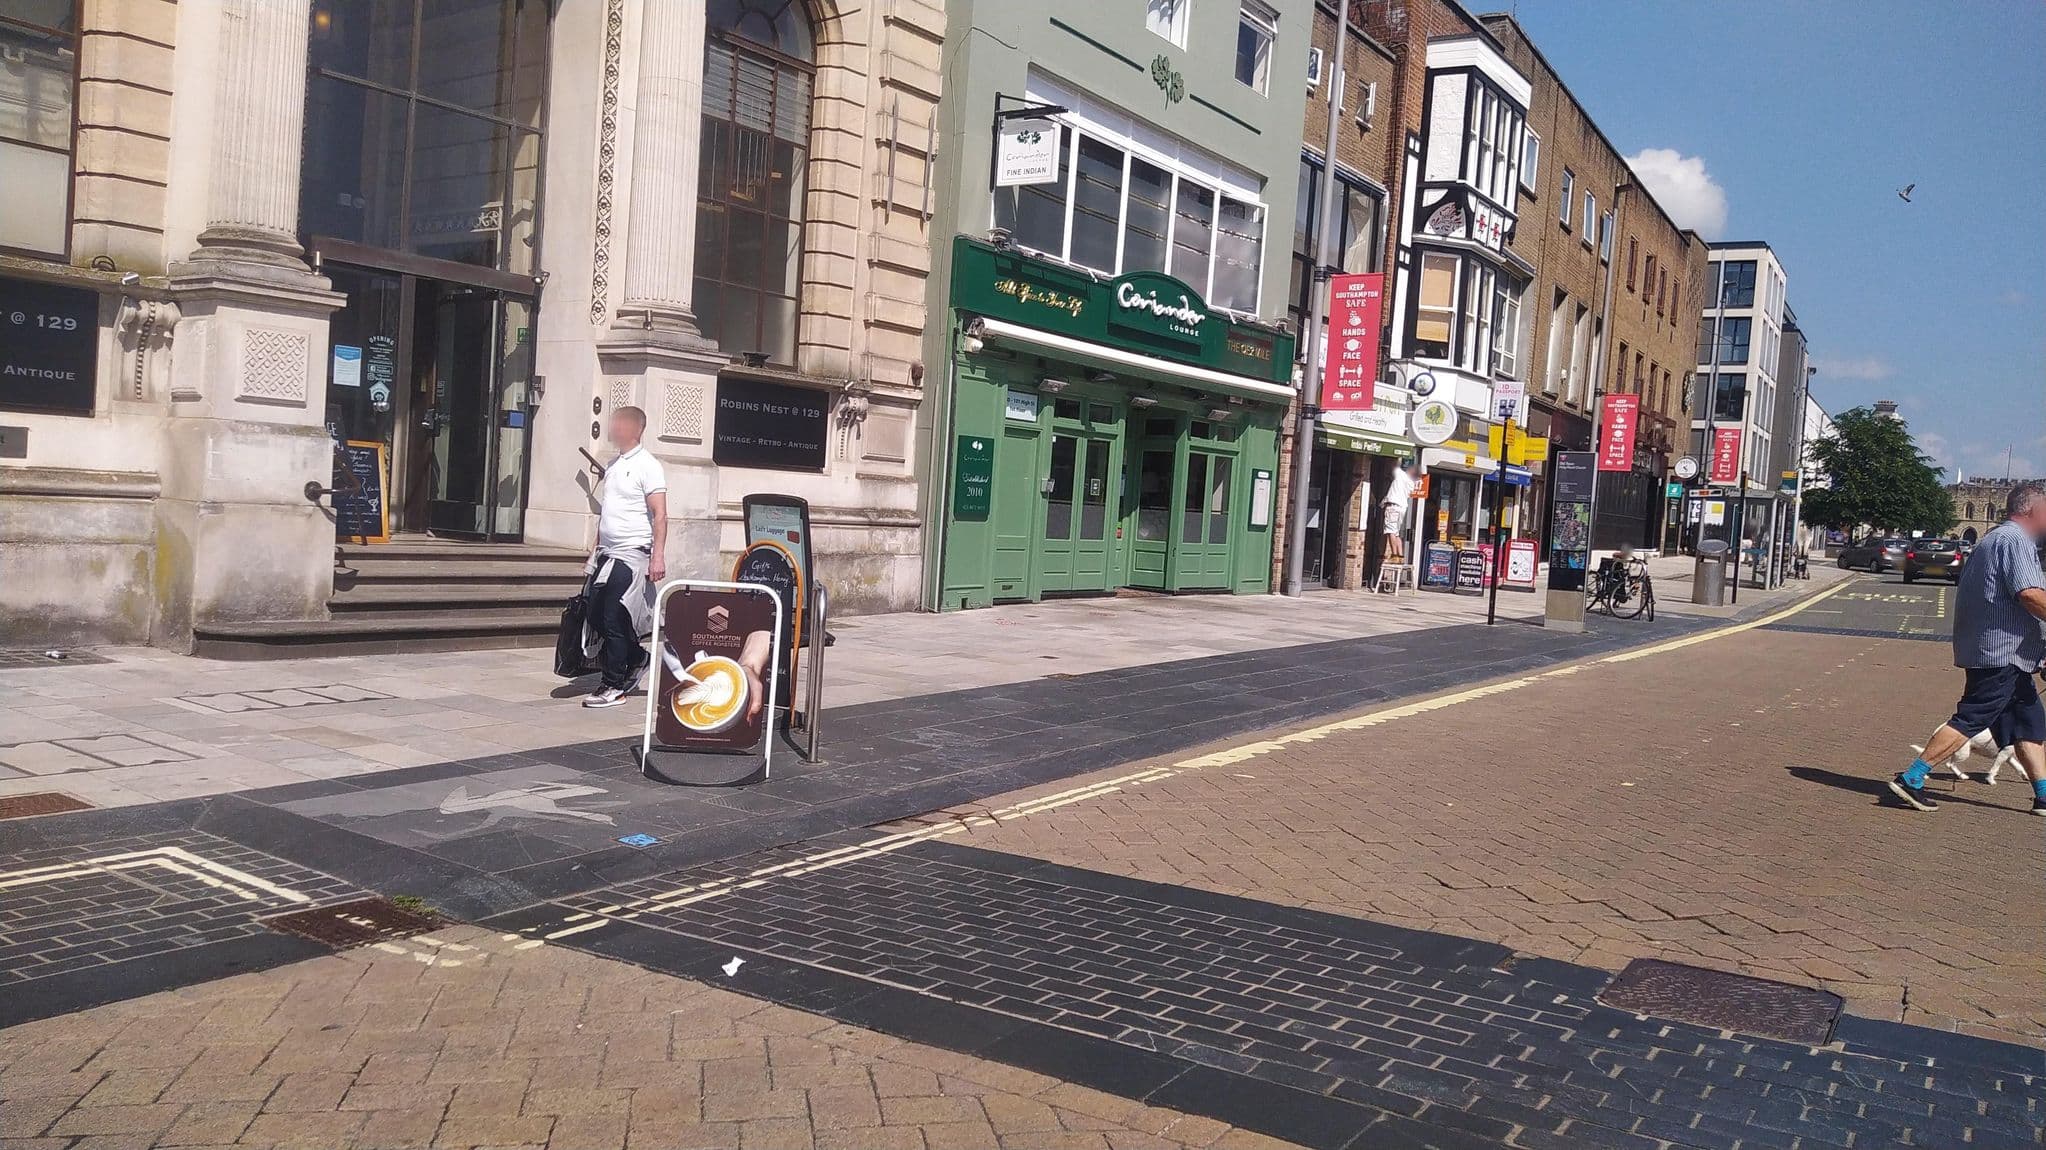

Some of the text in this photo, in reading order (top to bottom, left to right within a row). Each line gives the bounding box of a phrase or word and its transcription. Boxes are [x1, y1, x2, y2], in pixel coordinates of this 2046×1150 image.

[1007, 167, 1047, 176] FINE INDIAN
[1348, 283, 1365, 291] KEEP
[1336, 290, 1378, 299] SOUTHAMPTON
[1117, 282, 1206, 326] Coriander
[1345, 299, 1367, 308] SAFE
[10, 311, 26, 325] @
[37, 314, 78, 331] 129
[1169, 324, 1200, 337] LOUNGE
[1342, 328, 1366, 337] HANDS
[1226, 340, 1240, 353] THE
[1343, 351, 1362, 360] FACE
[3, 364, 77, 382] ANTIQUE
[1339, 379, 1362, 388] SPACE
[802, 407, 820, 418] 129
[966, 487, 984, 497] 2010
[1461, 556, 1483, 565] cash
[1458, 574, 1481, 585] here
[692, 633, 741, 641] SOUTHAMPTON
